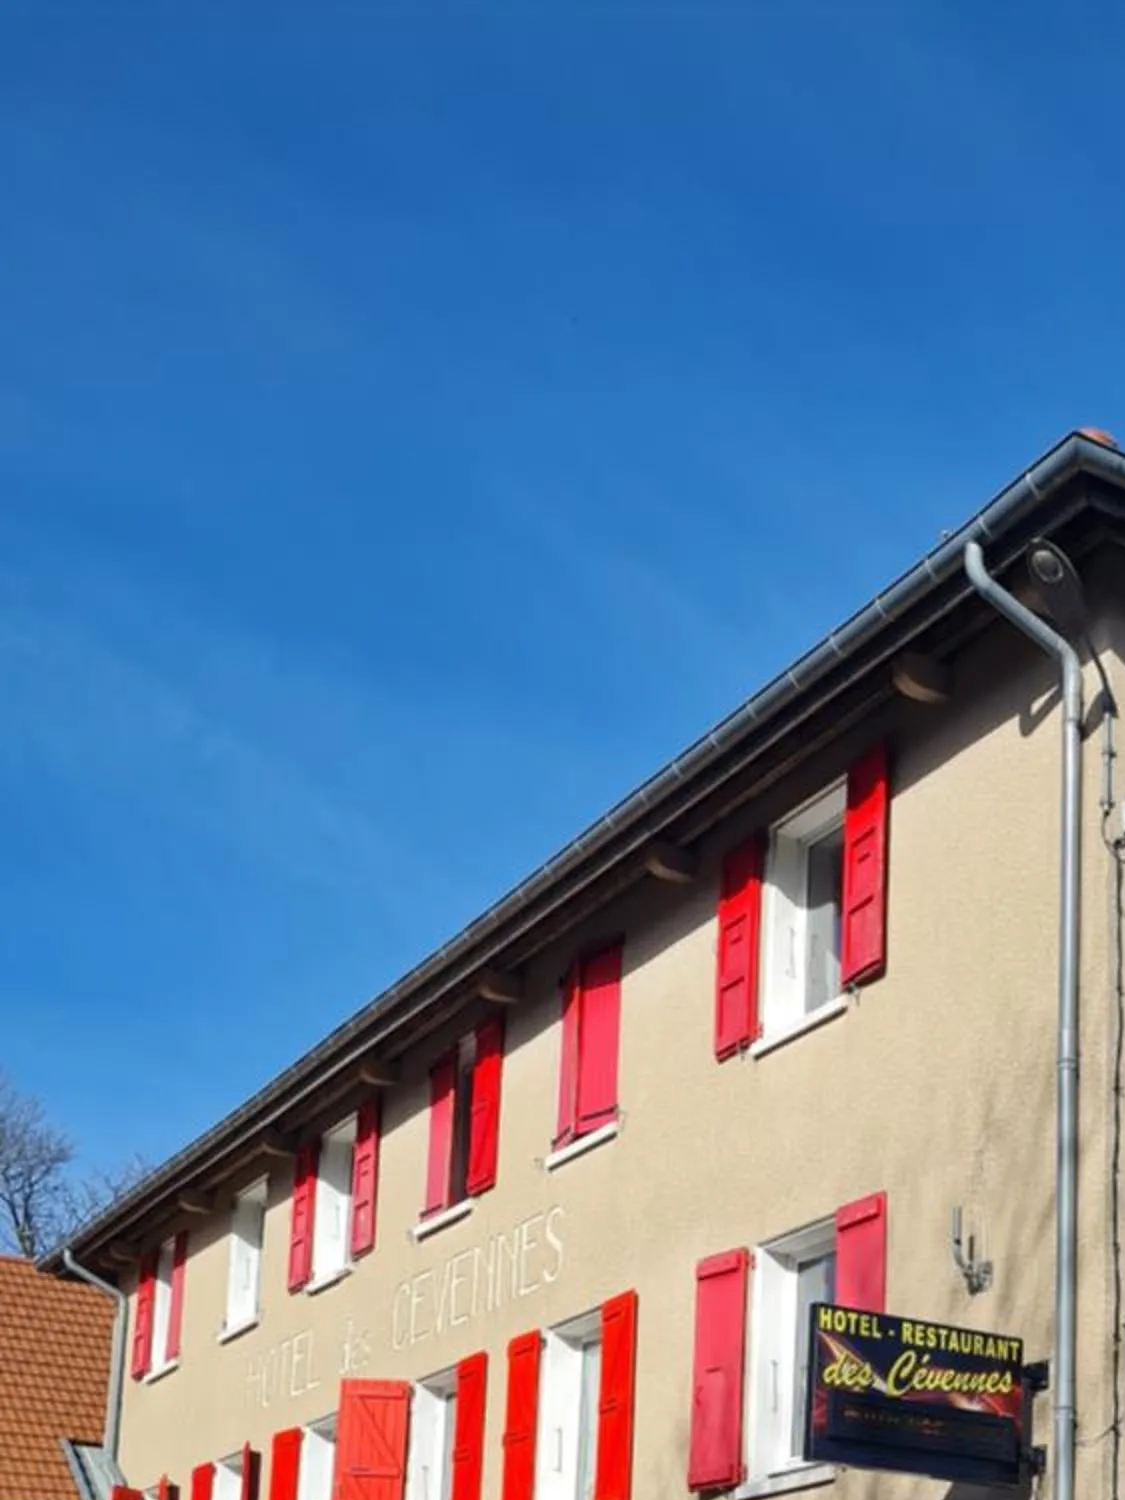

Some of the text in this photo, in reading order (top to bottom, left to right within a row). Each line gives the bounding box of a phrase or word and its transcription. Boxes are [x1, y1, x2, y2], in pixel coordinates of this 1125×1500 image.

[391, 1204, 564, 1352] CEVENNES
[818, 1306, 882, 1339] HOTEL
[901, 1321, 1020, 1362] RESTAURANT
[823, 1349, 1014, 1397] des Cévennes
